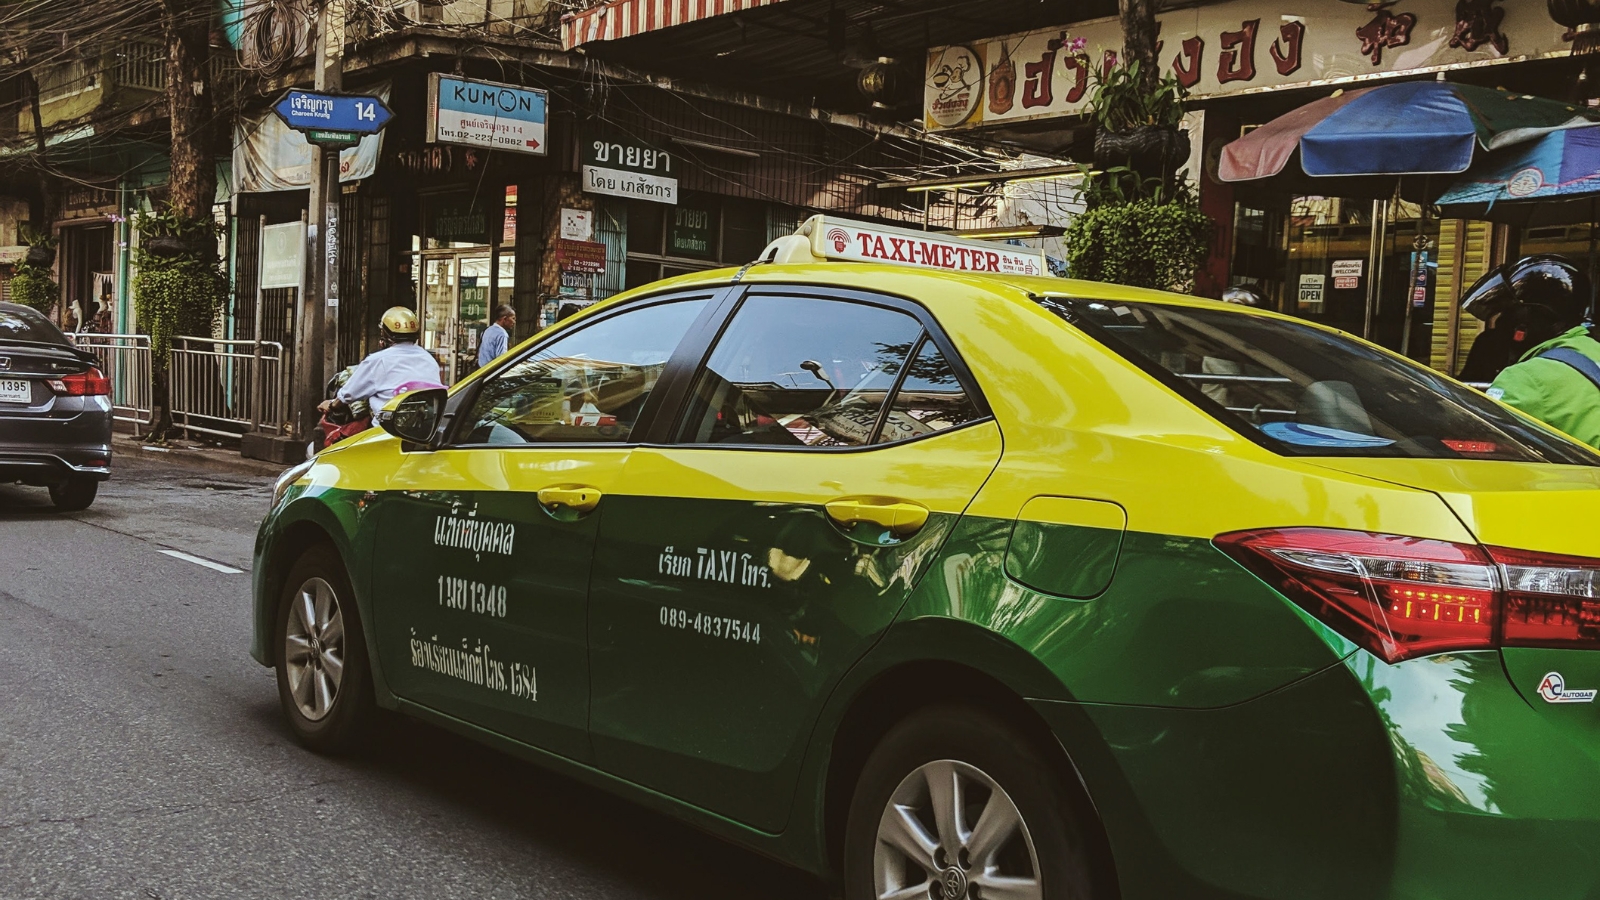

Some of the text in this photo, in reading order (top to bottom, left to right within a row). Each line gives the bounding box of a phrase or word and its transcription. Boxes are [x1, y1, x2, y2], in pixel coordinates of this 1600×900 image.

[291, 95, 376, 121] เจริญกรุง 14
[454, 86, 531, 112] KUMON
[593, 140, 671, 172] ขายยา
[589, 169, 672, 198] โดย เภสัชกร
[857, 233, 1001, 273] TAXI-METER
[1301, 290, 1321, 300] OPEN
[1, 380, 26, 392] 1395
[434, 501, 515, 562] แท็กซี่บุคคล
[659, 545, 771, 588] เรียก TAXI โทร.
[660, 606, 761, 644] 089-4837544
[510, 661, 537, 701] 1584
